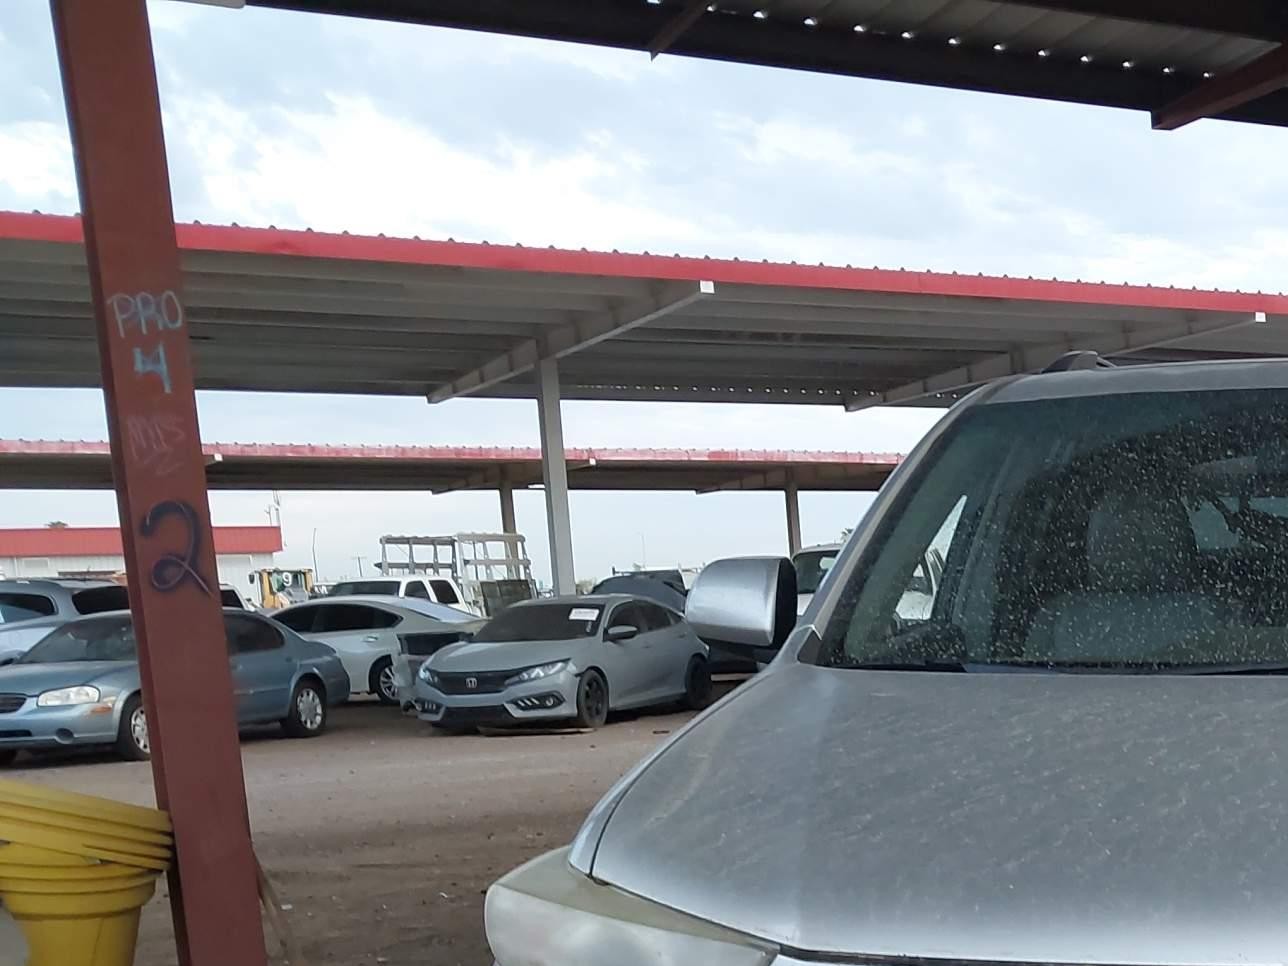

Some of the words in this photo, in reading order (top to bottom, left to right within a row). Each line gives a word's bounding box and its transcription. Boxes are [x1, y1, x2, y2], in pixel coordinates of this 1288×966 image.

[109, 291, 183, 337] PRO
[134, 343, 171, 393] 4
[141, 500, 212, 596] 2
[283, 572, 292, 586] 9
